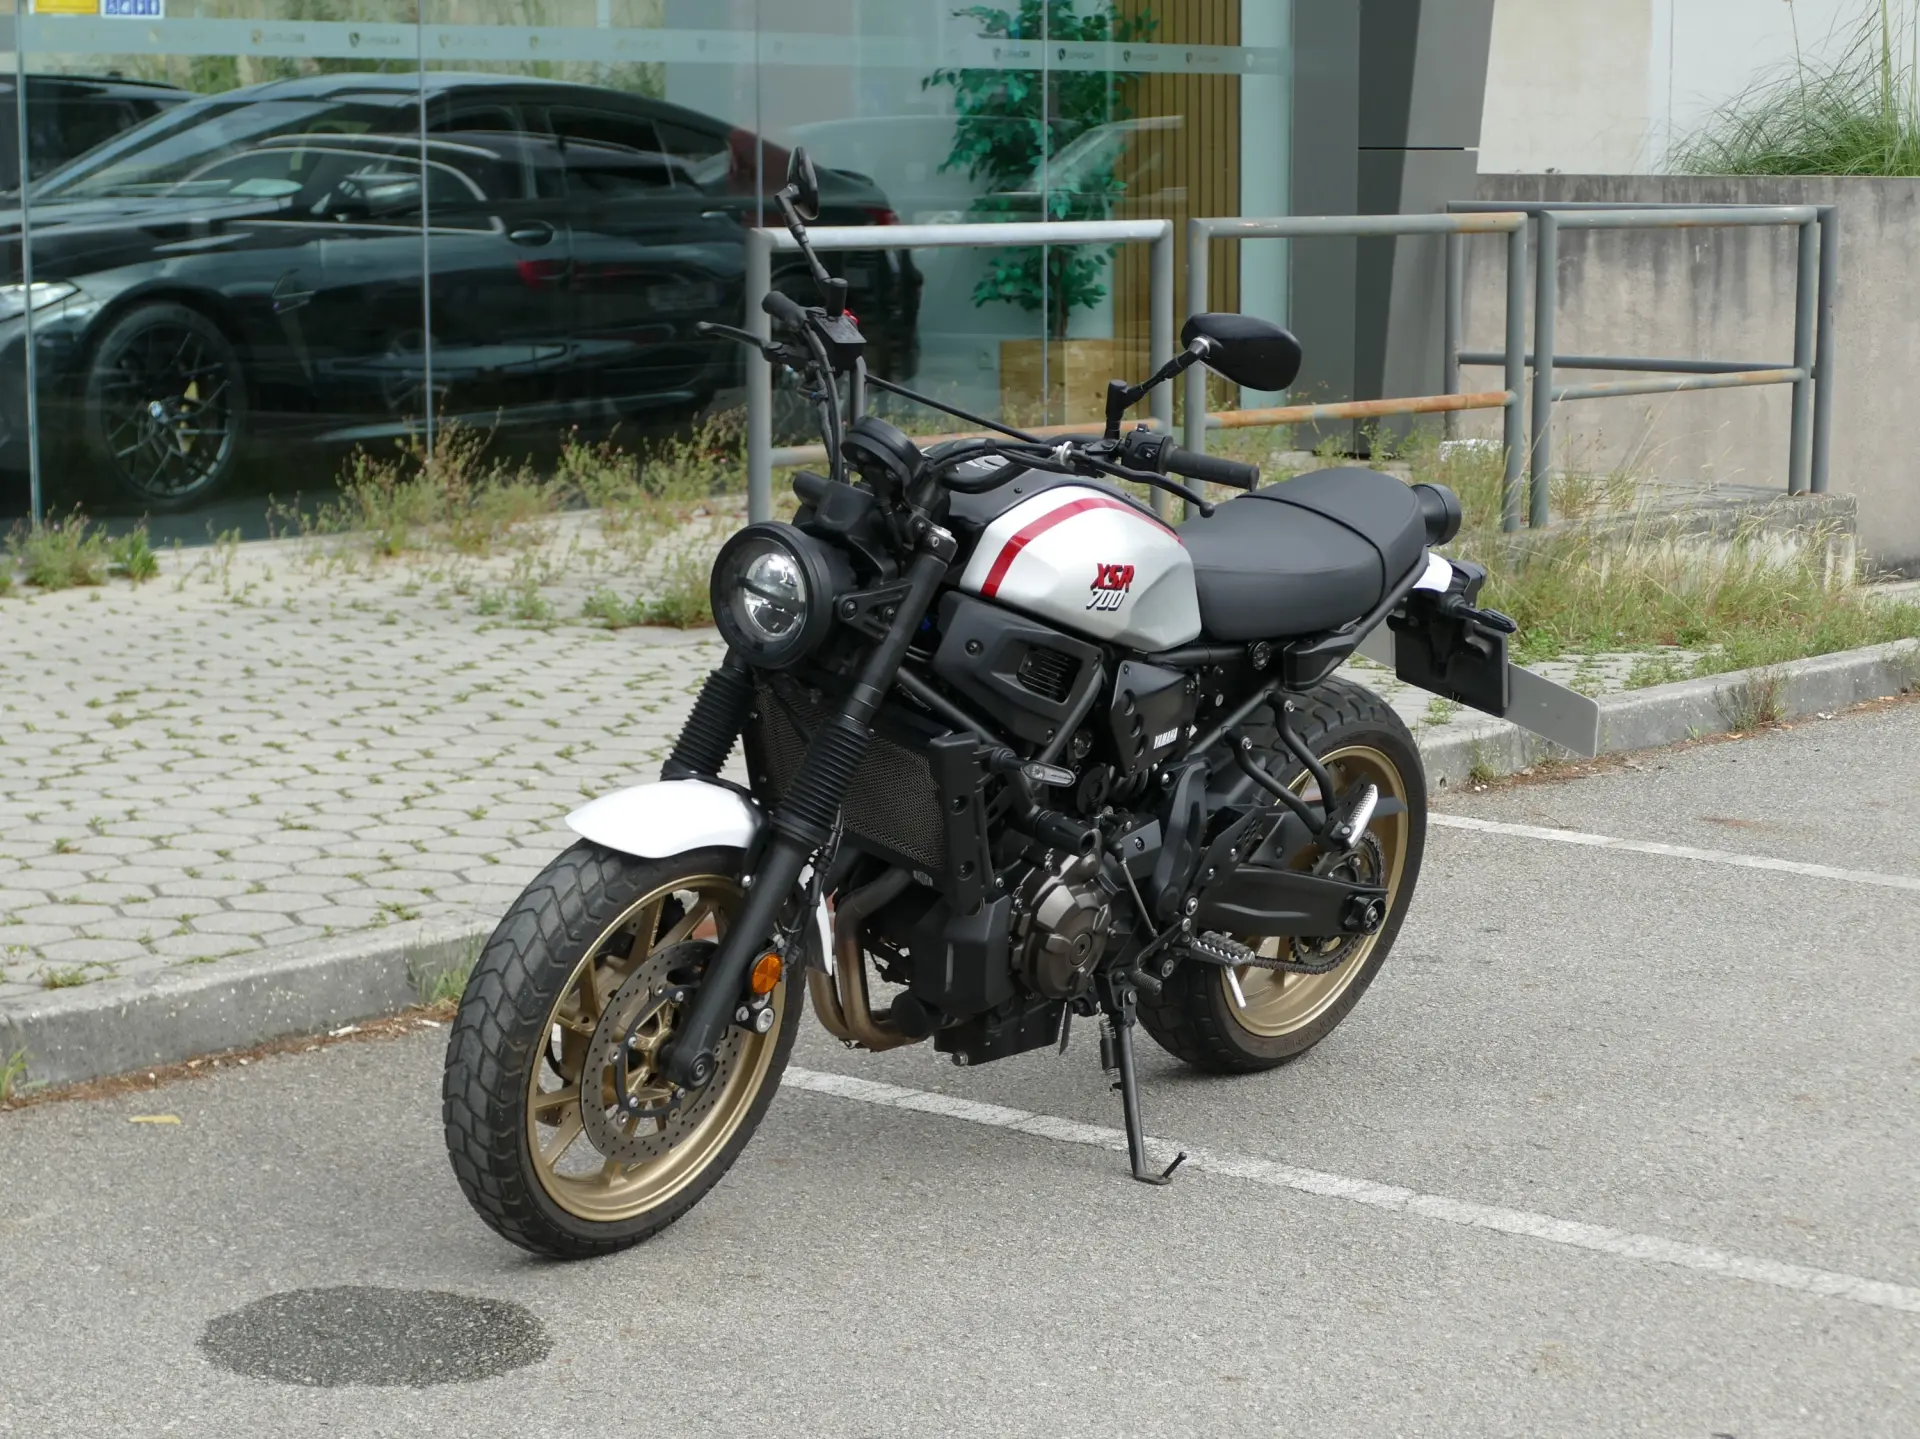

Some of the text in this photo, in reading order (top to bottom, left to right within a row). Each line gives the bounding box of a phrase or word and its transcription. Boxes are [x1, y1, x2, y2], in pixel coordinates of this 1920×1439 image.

[1090, 563, 1134, 593] XSR
[1086, 589, 1125, 611] 700
[1153, 727, 1178, 749] YAMAHA
